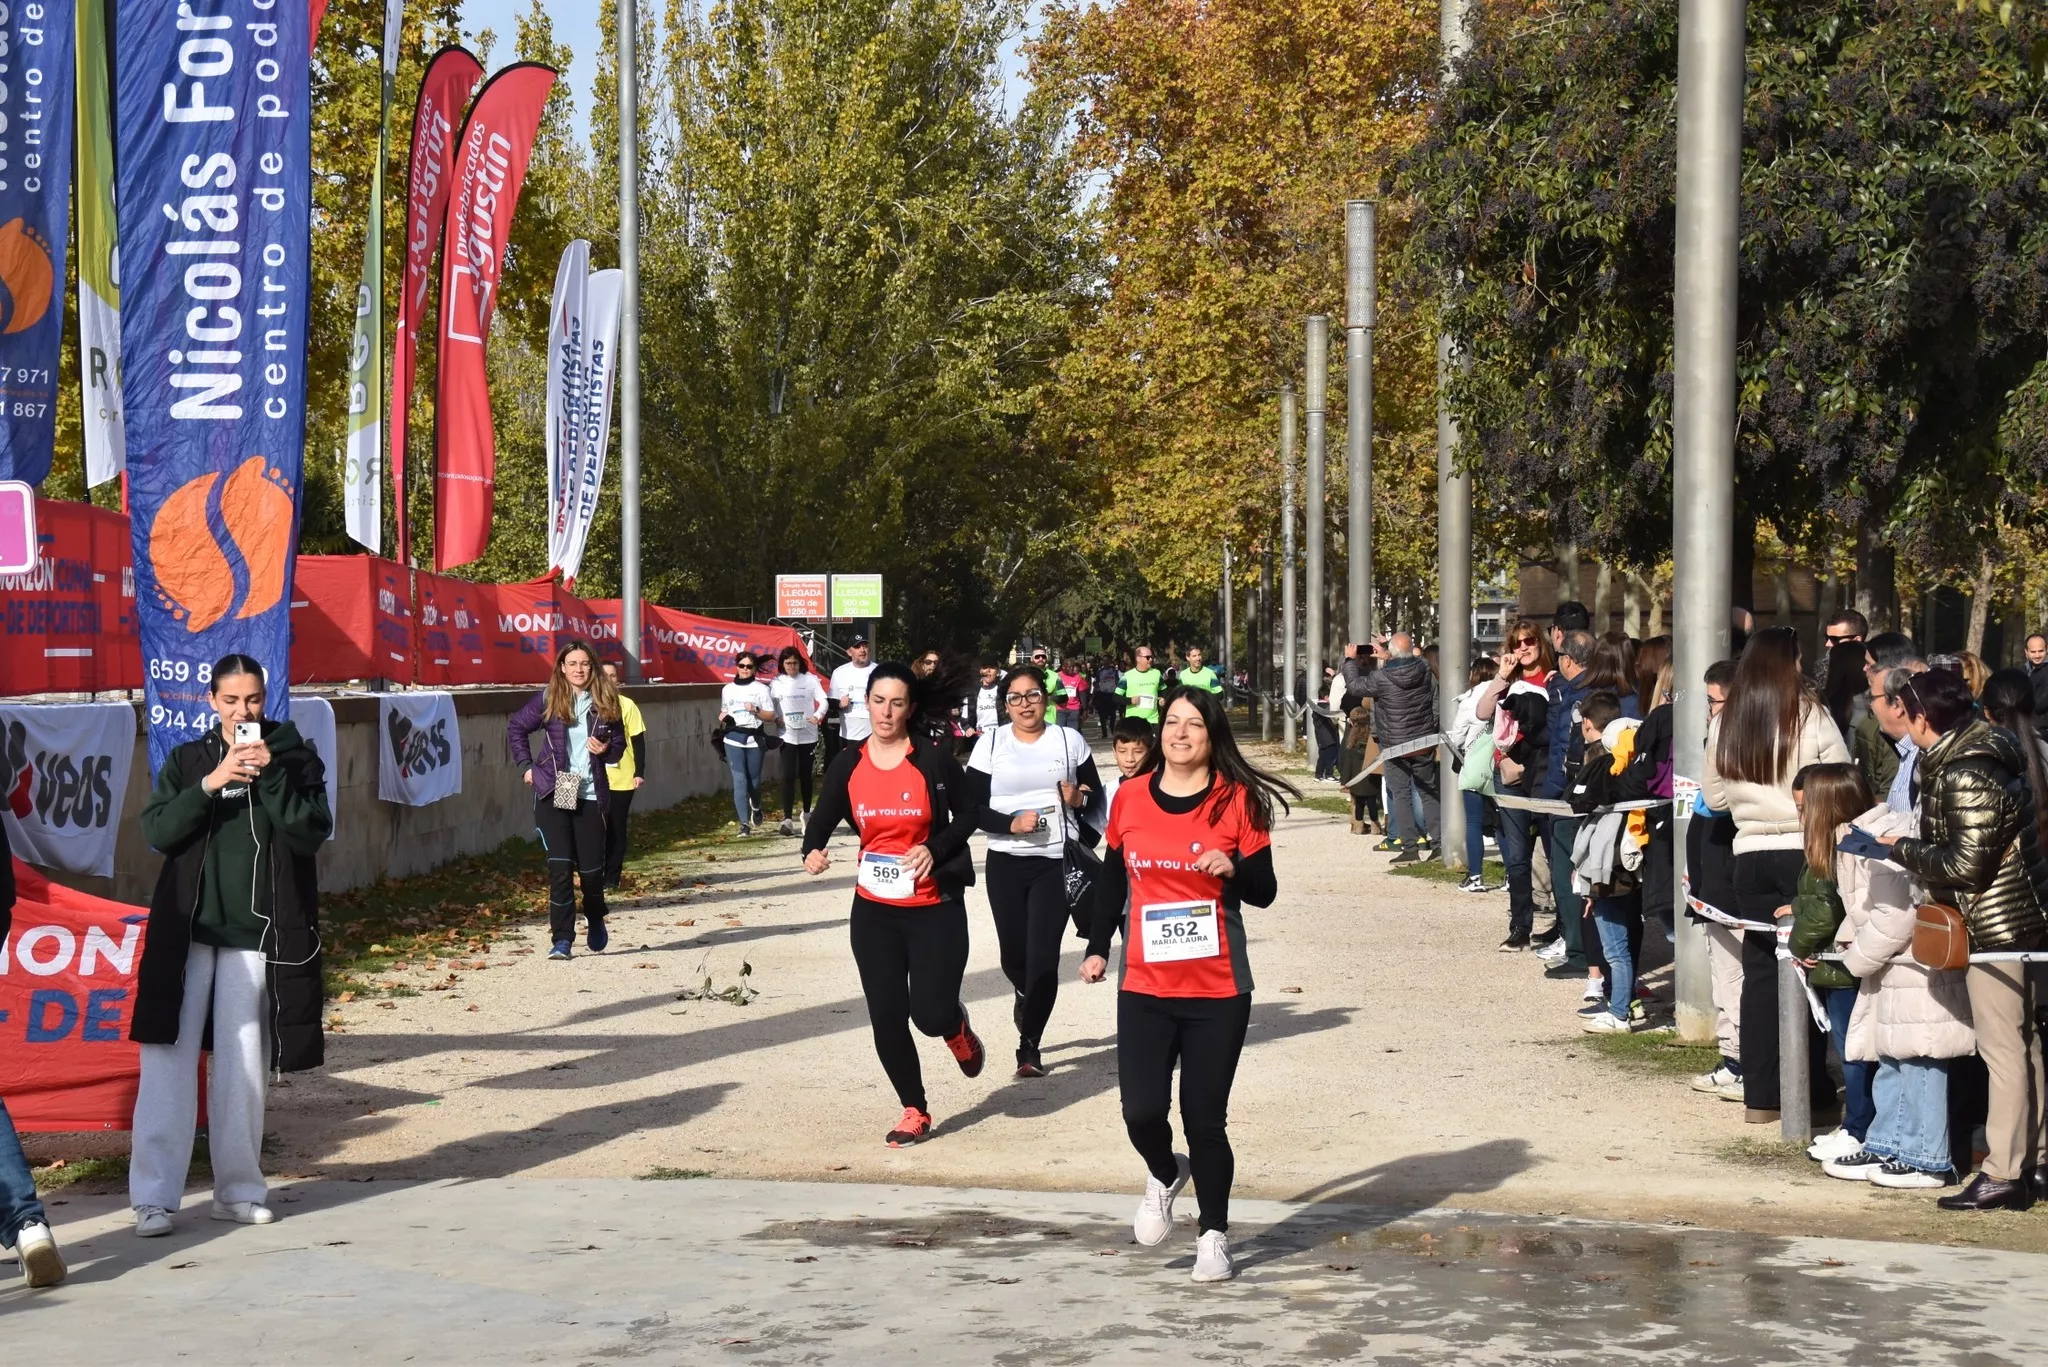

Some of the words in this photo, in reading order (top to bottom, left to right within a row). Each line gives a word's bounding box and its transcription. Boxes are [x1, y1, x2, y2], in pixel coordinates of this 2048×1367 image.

[20, 3, 45, 46] de
[20, 66, 43, 193] centro
[253, 152, 285, 212] de
[163, 153, 243, 419] Nicolás
[256, 243, 287, 419] centro
[17, 368, 49, 384] 971
[13, 402, 47, 418] 867
[781, 589, 823, 597] LLEGADA
[785, 599, 805, 607] 1250
[807, 599, 819, 607] de
[787, 607, 806, 615] 1250
[657, 628, 746, 654] MONZÓN
[150, 658, 190, 682] 659
[856, 809, 877, 817] TEAM
[878, 808, 897, 816] YOU
[898, 808, 923, 816] LOVE
[1128, 859, 1151, 869] TEAM
[1155, 860, 1181, 870] YOU
[873, 866, 900, 880] 569
[877, 877, 894, 885] SARA
[1161, 921, 1199, 939] 562
[1151, 938, 1178, 947] MARIA
[1180, 934, 1209, 945] LAURA
[25, 988, 128, 1043] DE
